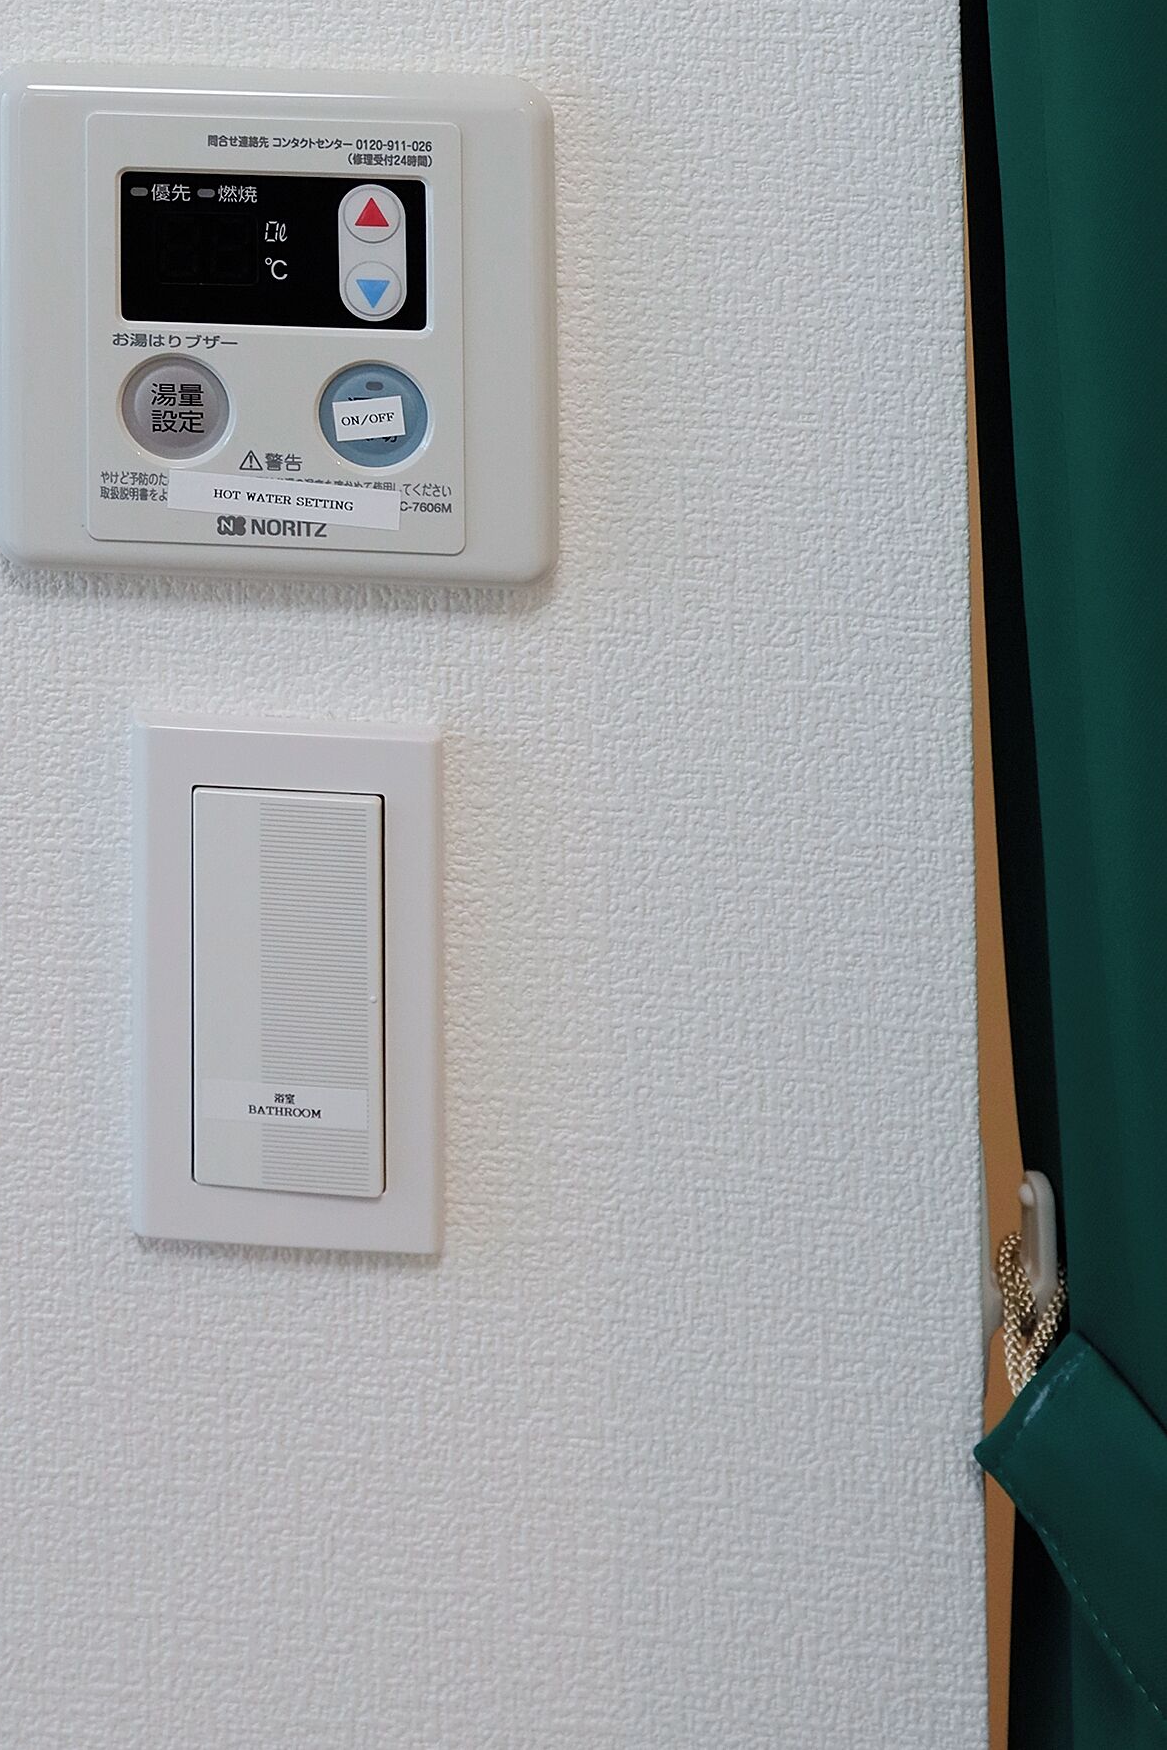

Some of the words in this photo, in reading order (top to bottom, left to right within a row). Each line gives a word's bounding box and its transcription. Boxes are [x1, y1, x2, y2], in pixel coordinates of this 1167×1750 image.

[272, 137, 353, 150] コンタクトセンター
[355, 139, 433, 152] 0120-911-026
[151, 183, 191, 201] 優先
[217, 185, 258, 203] 燃焼
[112, 332, 239, 349] お湯はりブザー
[150, 382, 205, 407] 湯量
[150, 409, 205, 433] 設定
[341, 412, 395, 426] ON/OFF
[265, 453, 303, 472] 警告
[214, 488, 241, 500] HOT
[246, 491, 292, 506] WATER
[296, 496, 354, 512] SETTING
[251, 519, 328, 538] NORITZ
[274, 1093, 295, 1105] 浴室
[248, 1104, 322, 1119] BATHROOM
